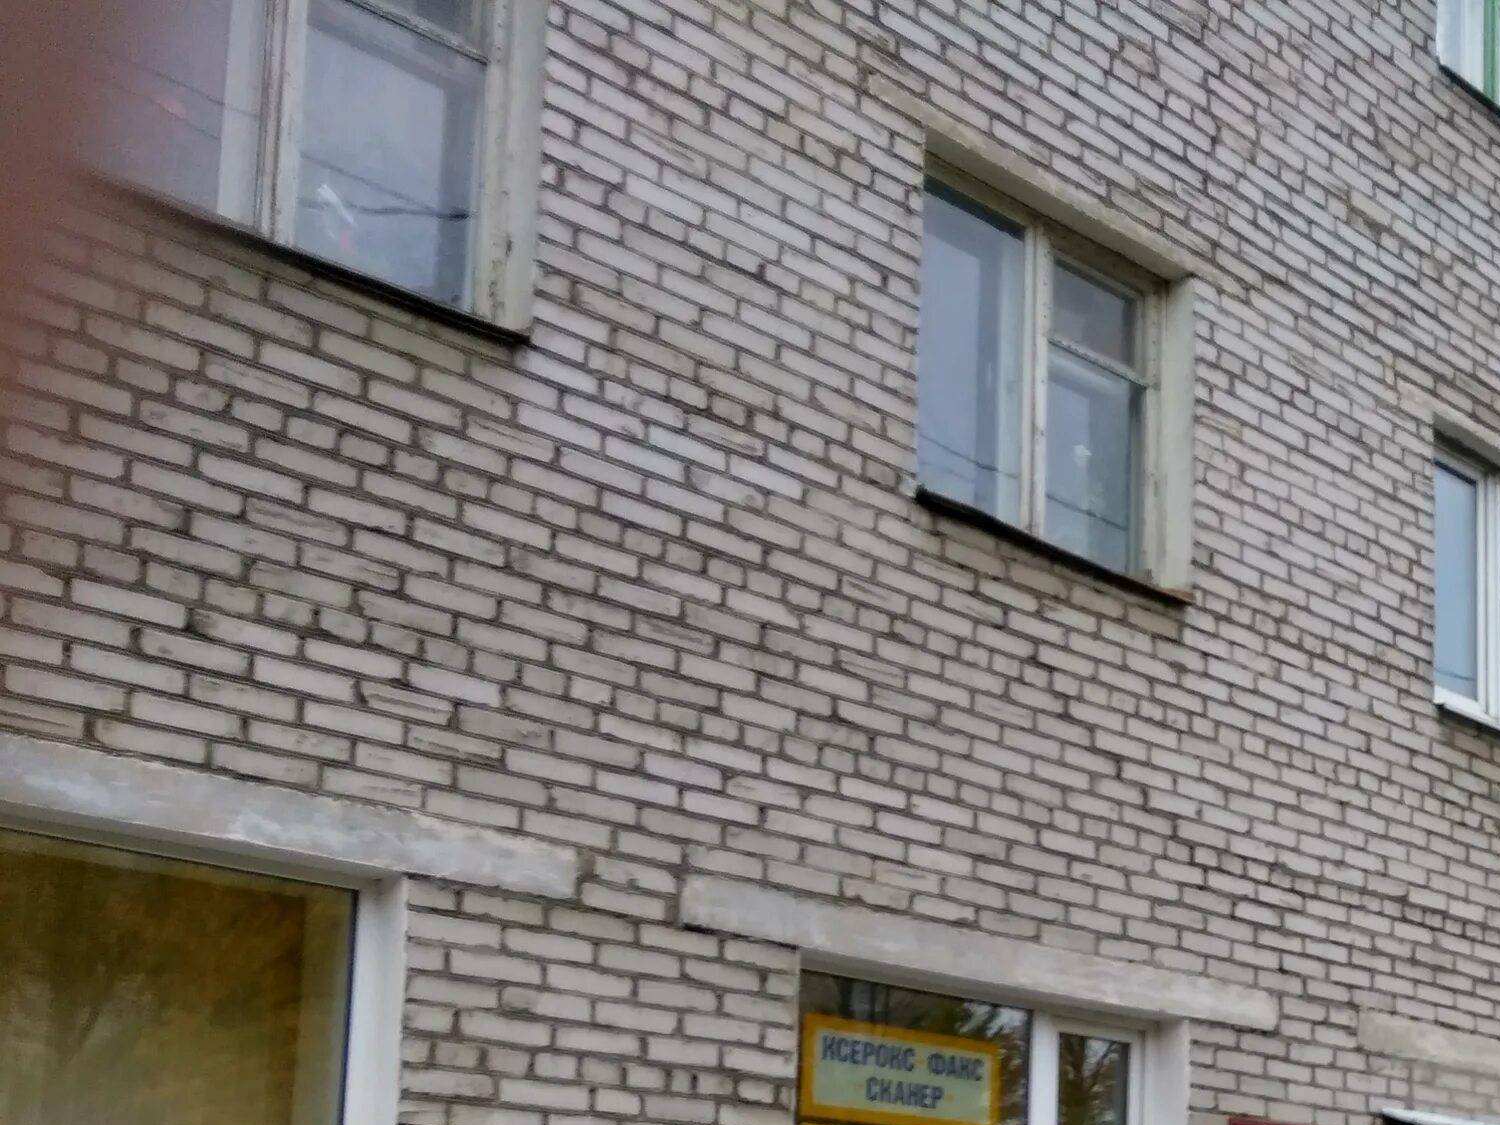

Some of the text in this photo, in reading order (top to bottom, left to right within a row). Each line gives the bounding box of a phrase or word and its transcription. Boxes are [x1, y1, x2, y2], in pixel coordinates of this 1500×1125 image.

[821, 1034, 985, 1082] КСЕРОКС ФАКС
[865, 1076, 944, 1109] СКАНЕР
